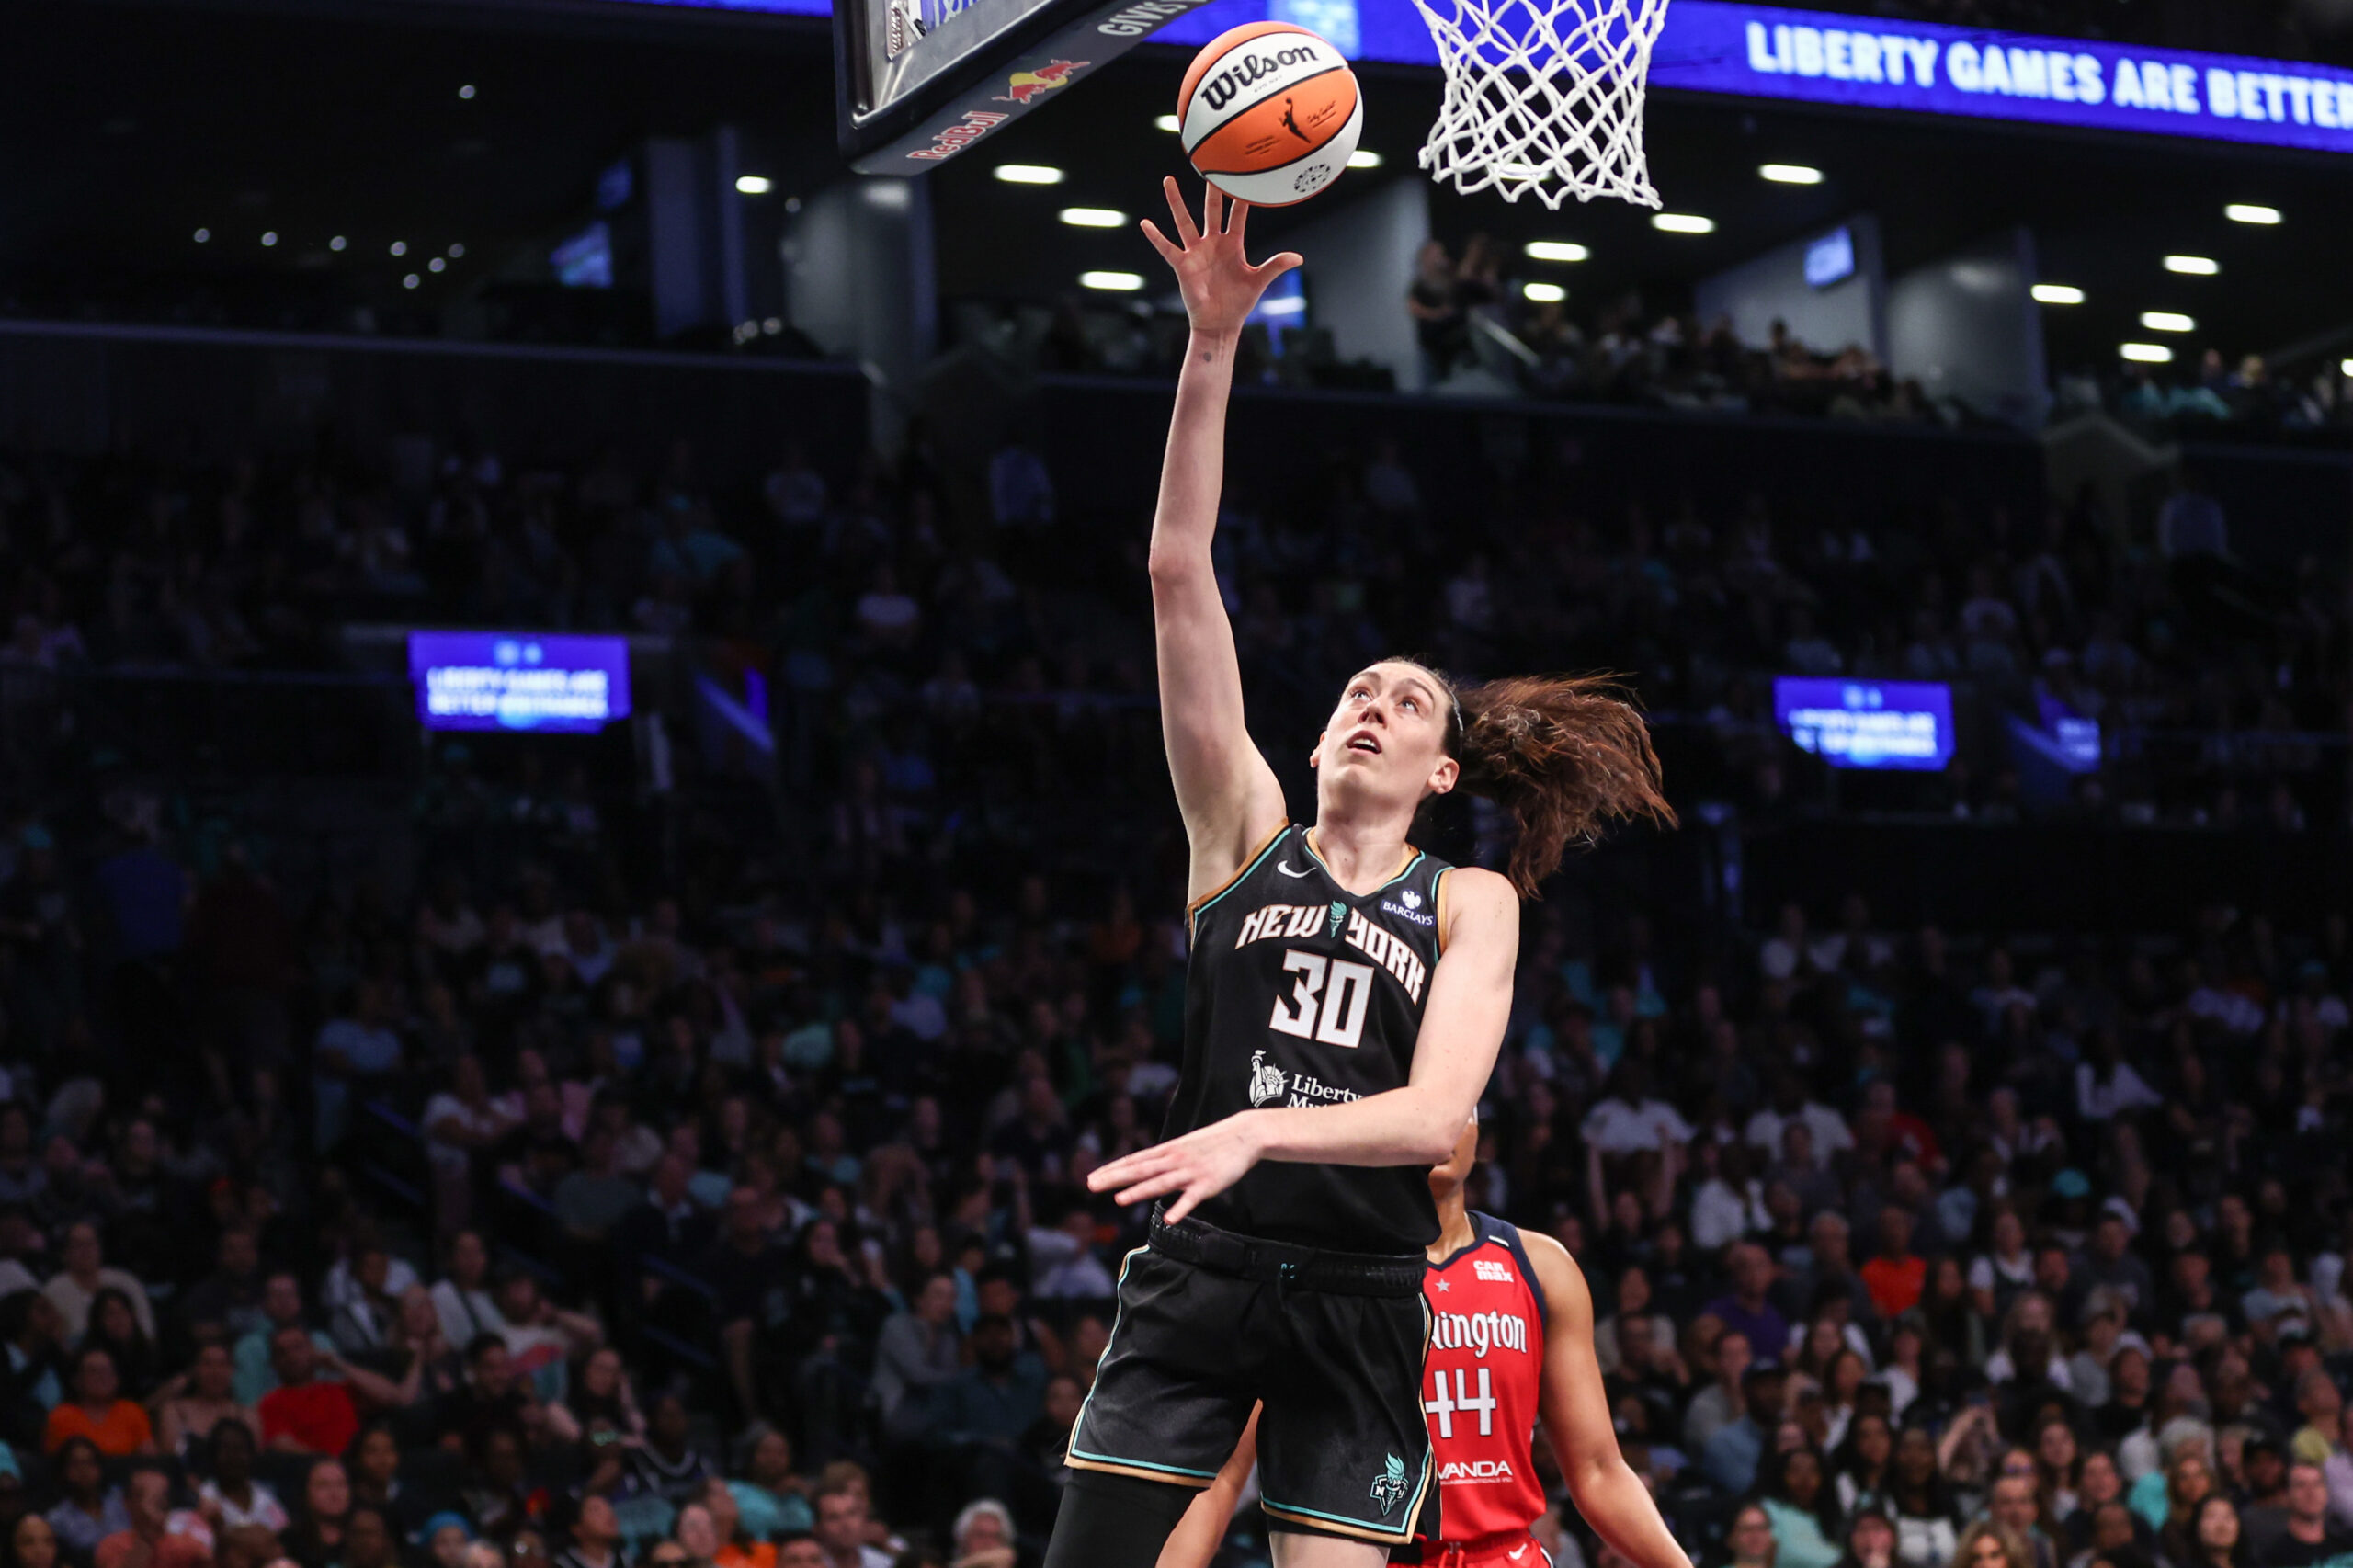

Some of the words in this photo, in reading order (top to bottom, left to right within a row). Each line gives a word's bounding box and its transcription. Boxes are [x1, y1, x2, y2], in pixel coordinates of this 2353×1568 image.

[1200, 46, 1319, 111] Wilson
[1746, 20, 1939, 88] LIBERTY
[1946, 40, 2106, 105] GAMES
[2113, 57, 2201, 115] ARE
[1382, 901, 1434, 926] BARCLAYS
[1235, 904, 1327, 949] NEW
[1345, 907, 1426, 1006] YORK
[1268, 949, 1374, 1049] 30
[1473, 1260, 1505, 1272] CAR
[1425, 1367, 1496, 1438] 44
